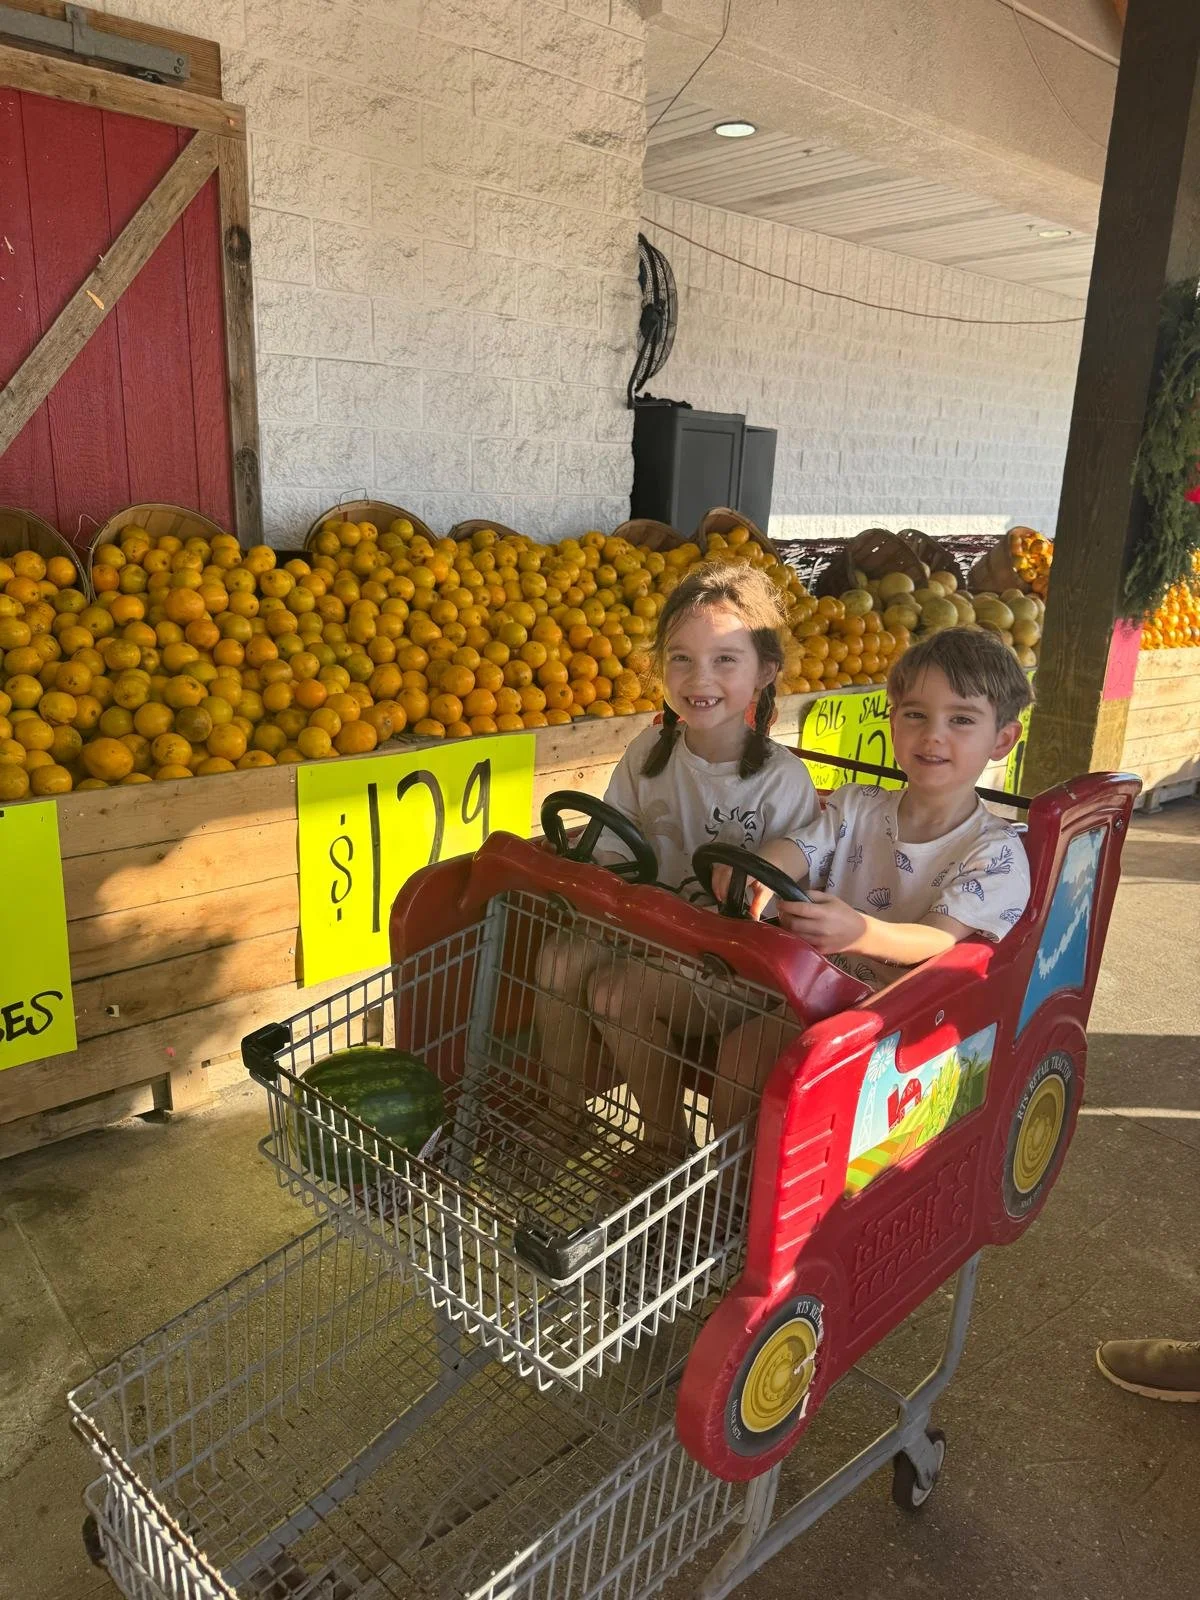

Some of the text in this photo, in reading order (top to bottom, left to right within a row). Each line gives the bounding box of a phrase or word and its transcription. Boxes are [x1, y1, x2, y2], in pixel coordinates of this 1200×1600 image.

[816, 695, 890, 736] BIG SALE
[0, 990, 63, 1042] ES
[1016, 1055, 1072, 1120] RTS RETAIL TRACTOR
[795, 1301, 810, 1314] RTS
